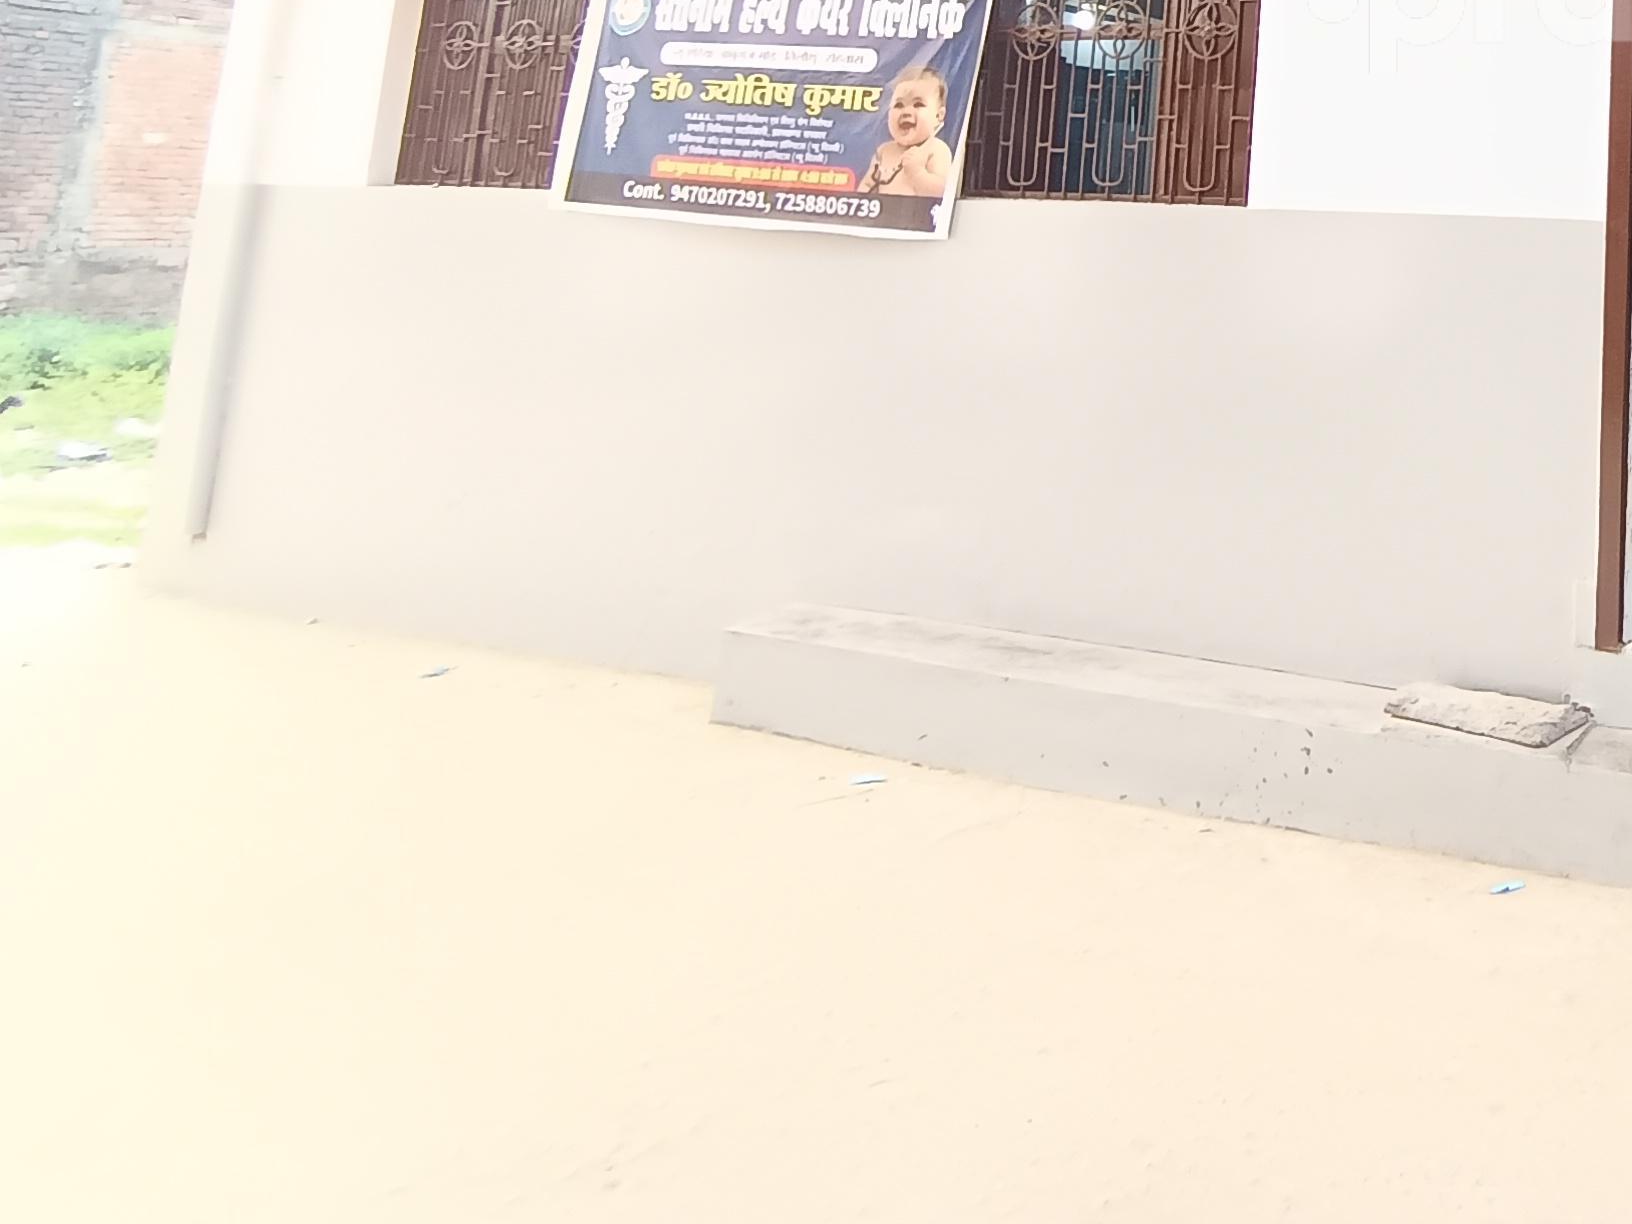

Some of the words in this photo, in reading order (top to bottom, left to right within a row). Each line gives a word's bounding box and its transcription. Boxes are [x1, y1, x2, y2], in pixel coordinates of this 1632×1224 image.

[700, 73, 796, 108] ज्योतिष
[803, 84, 883, 116] कुमार
[623, 180, 664, 200] Cont.
[670, 186, 771, 213] 9470207291,
[775, 191, 881, 218] 7258806739
